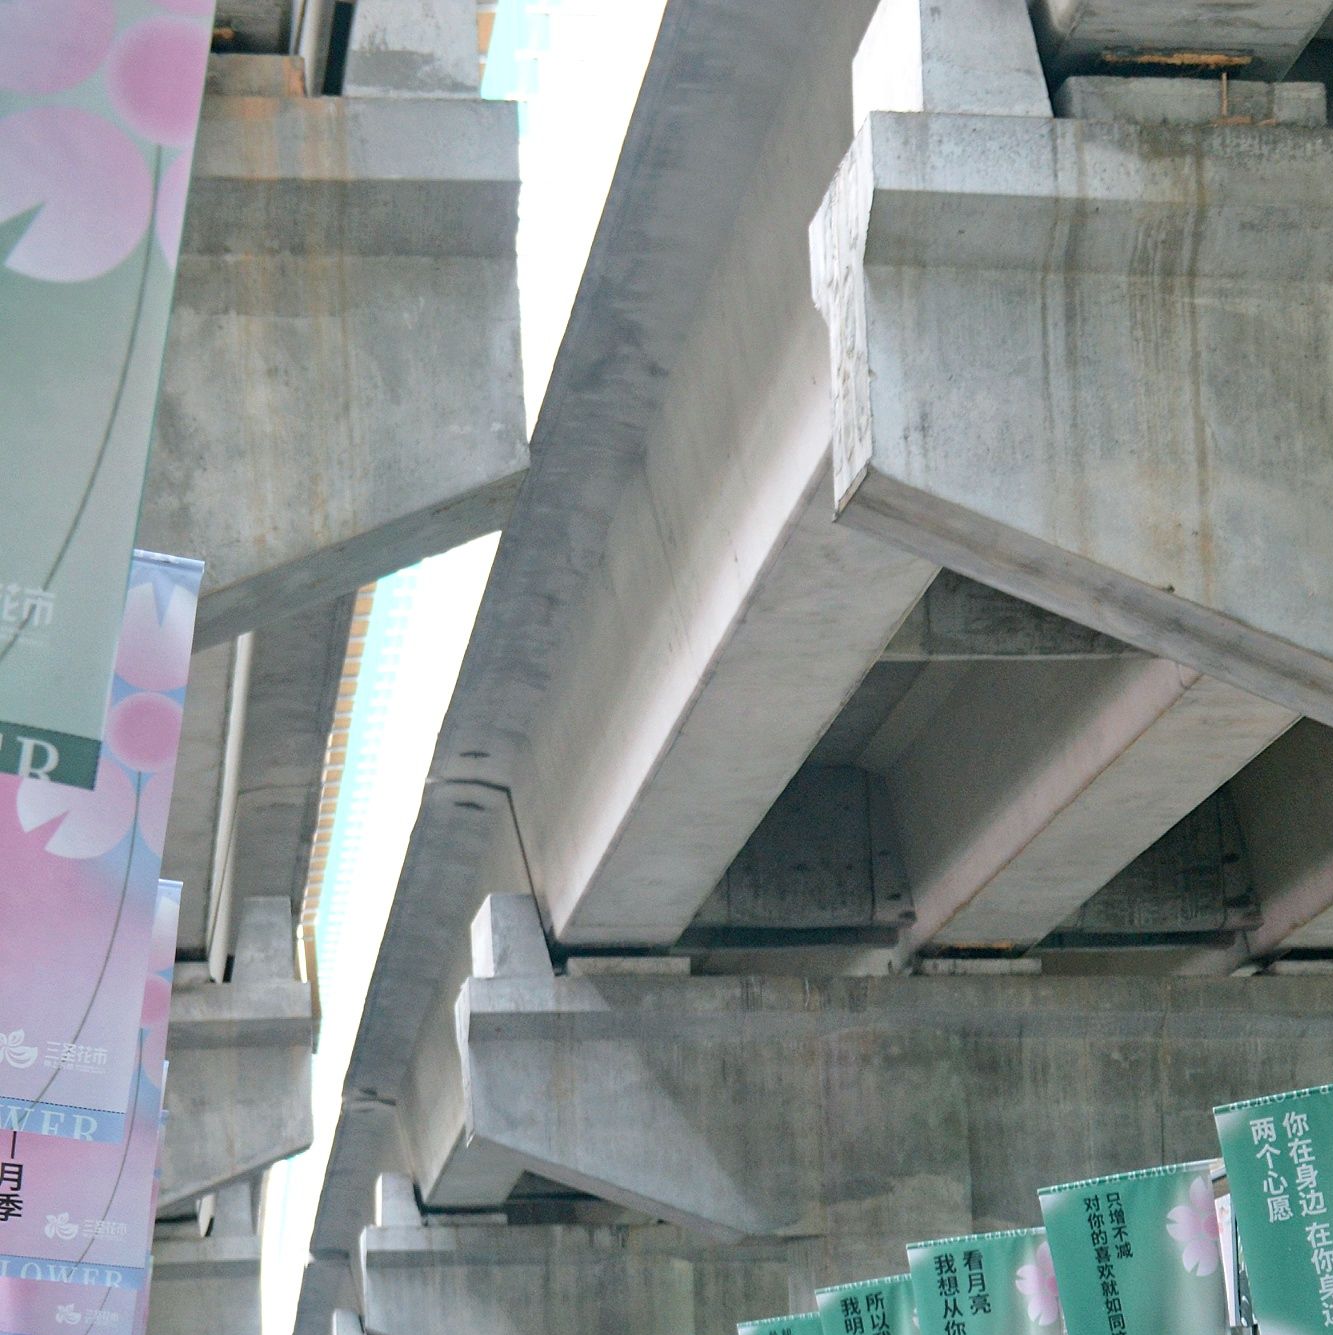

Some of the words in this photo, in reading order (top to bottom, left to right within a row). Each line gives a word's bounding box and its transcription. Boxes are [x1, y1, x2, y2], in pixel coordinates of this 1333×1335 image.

[1250, 1116, 1294, 1223] 两个心愿
[1106, 1191, 1134, 1259] 只增不减
[963, 1250, 992, 1315] 看月亮
